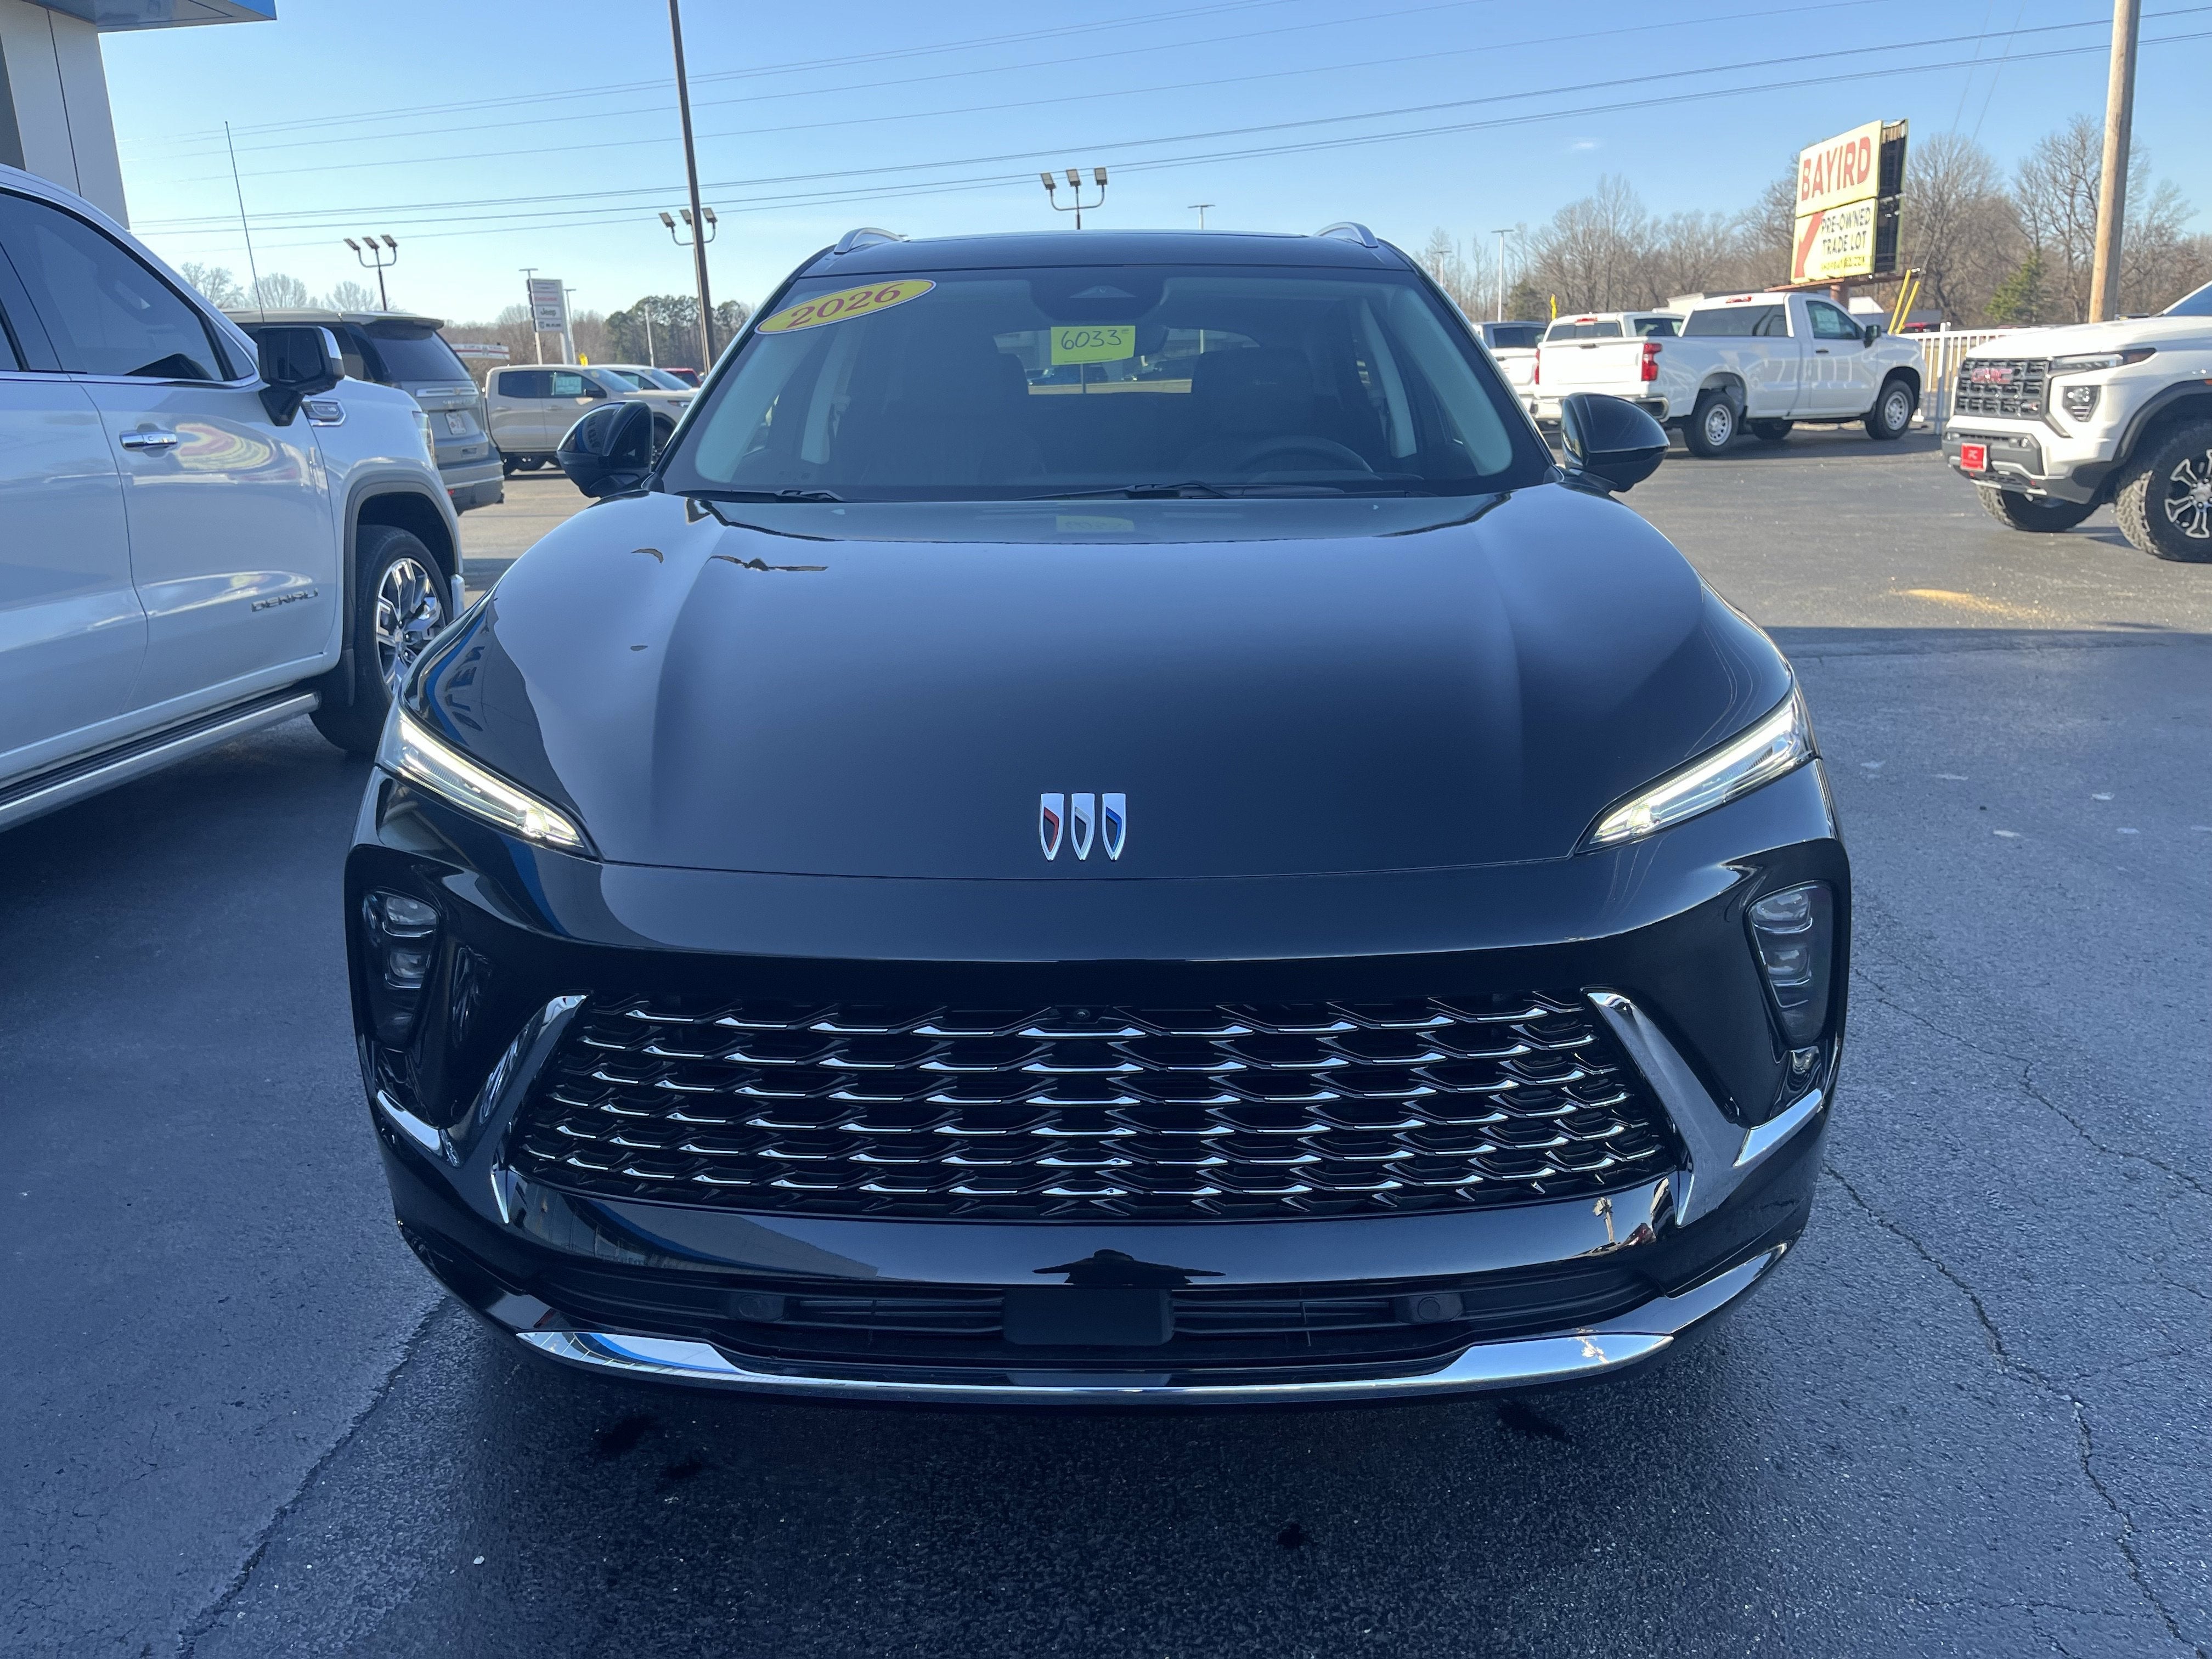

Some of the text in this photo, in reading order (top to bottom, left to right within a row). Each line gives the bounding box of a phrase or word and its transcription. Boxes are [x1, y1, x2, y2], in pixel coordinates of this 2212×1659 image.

[1801, 136, 1871, 201] BAYIRD
[1821, 207, 1871, 234] PRE-OWNED
[1822, 230, 1867, 255] TRADE LOT
[786, 283, 904, 329] 2026
[1061, 330, 1122, 350] 6033
[251, 588, 318, 612] DENALI
